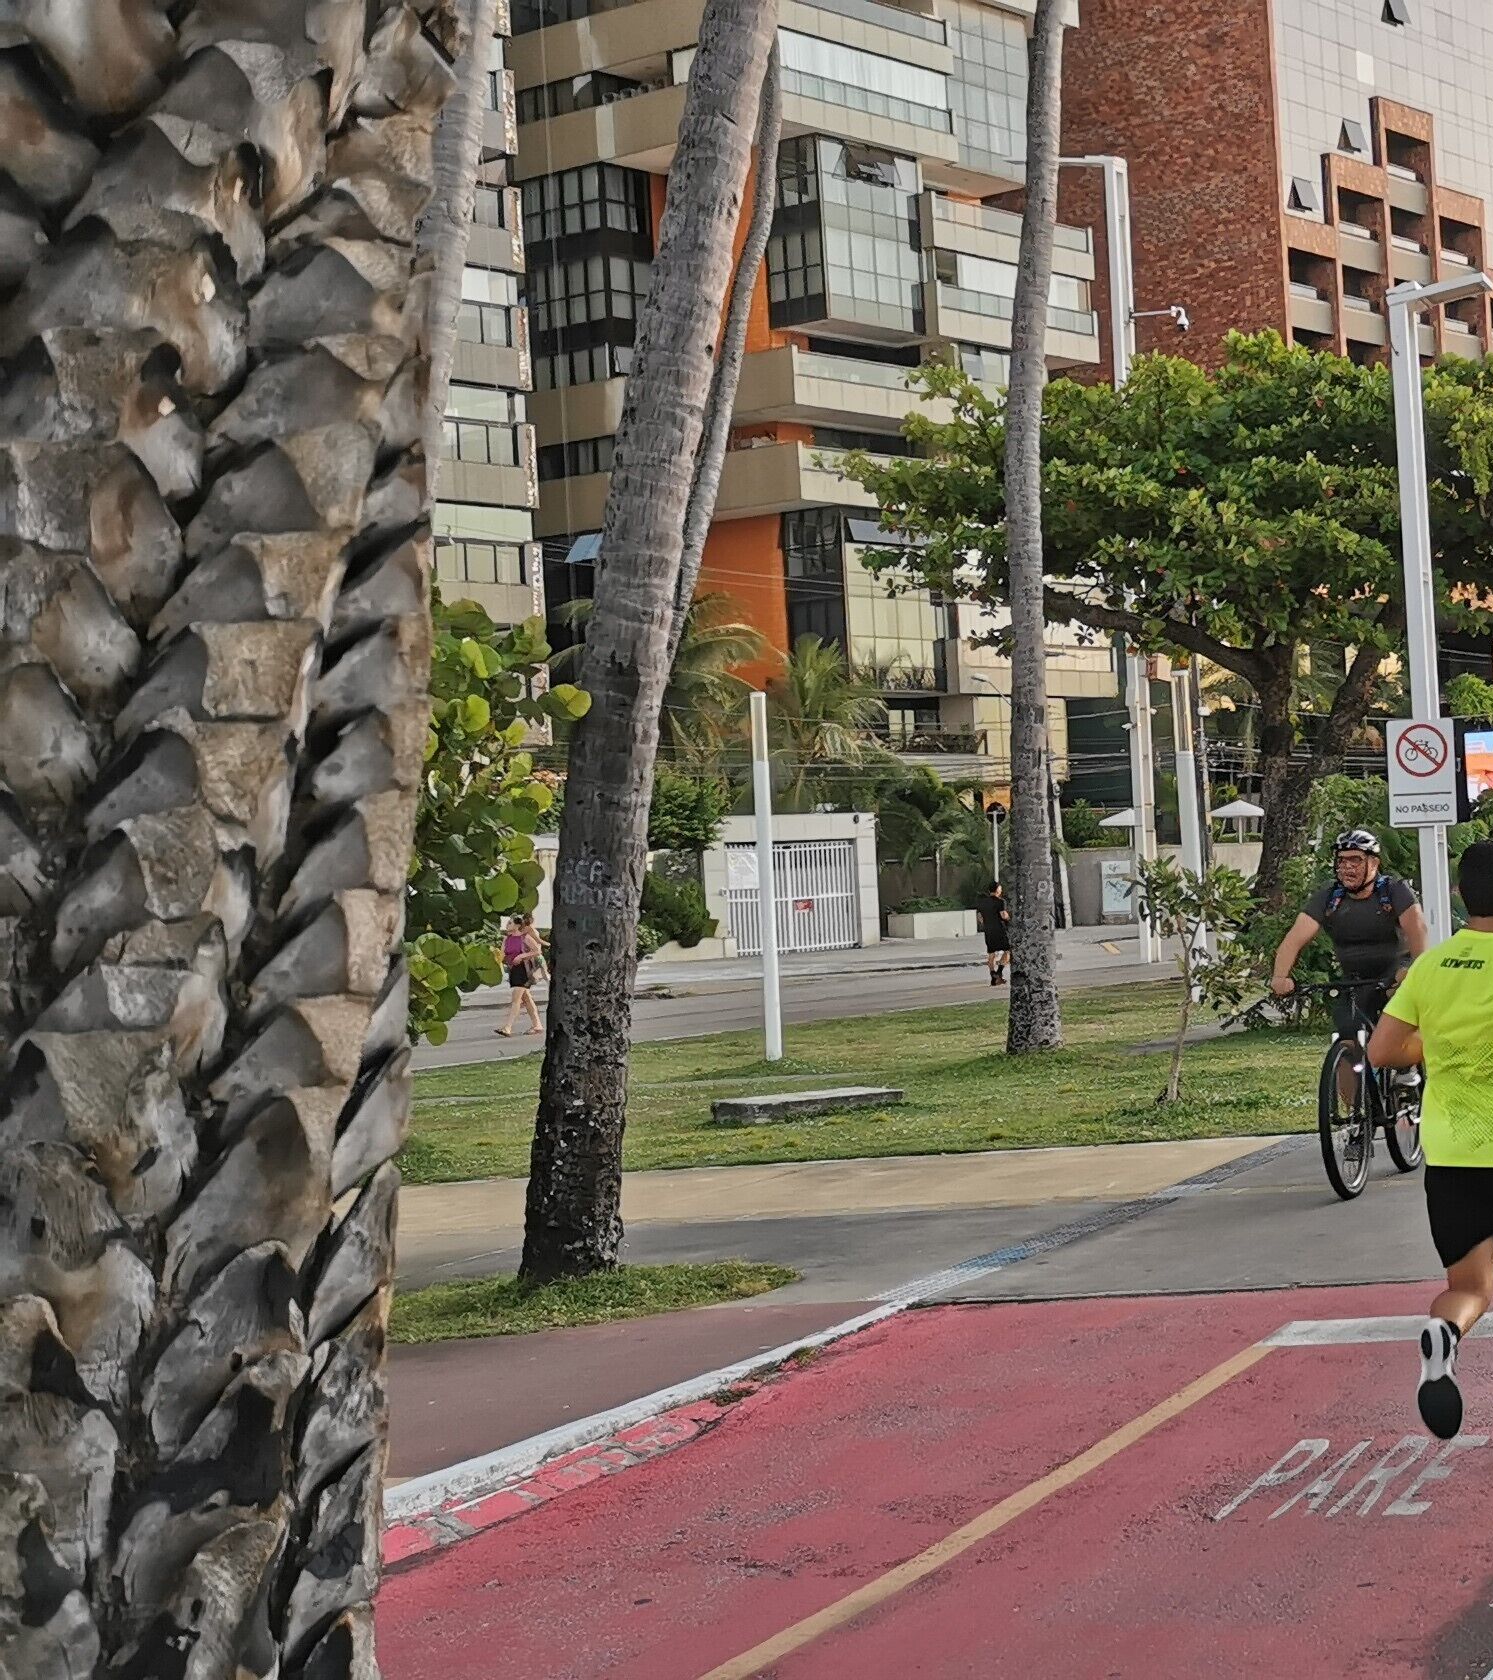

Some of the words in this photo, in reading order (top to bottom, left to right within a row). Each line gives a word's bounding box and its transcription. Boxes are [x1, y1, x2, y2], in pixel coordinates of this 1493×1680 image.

[1395, 805, 1409, 814] NO
[1411, 803, 1450, 813] PASSEIO
[1213, 1434, 1491, 1522] PARE
